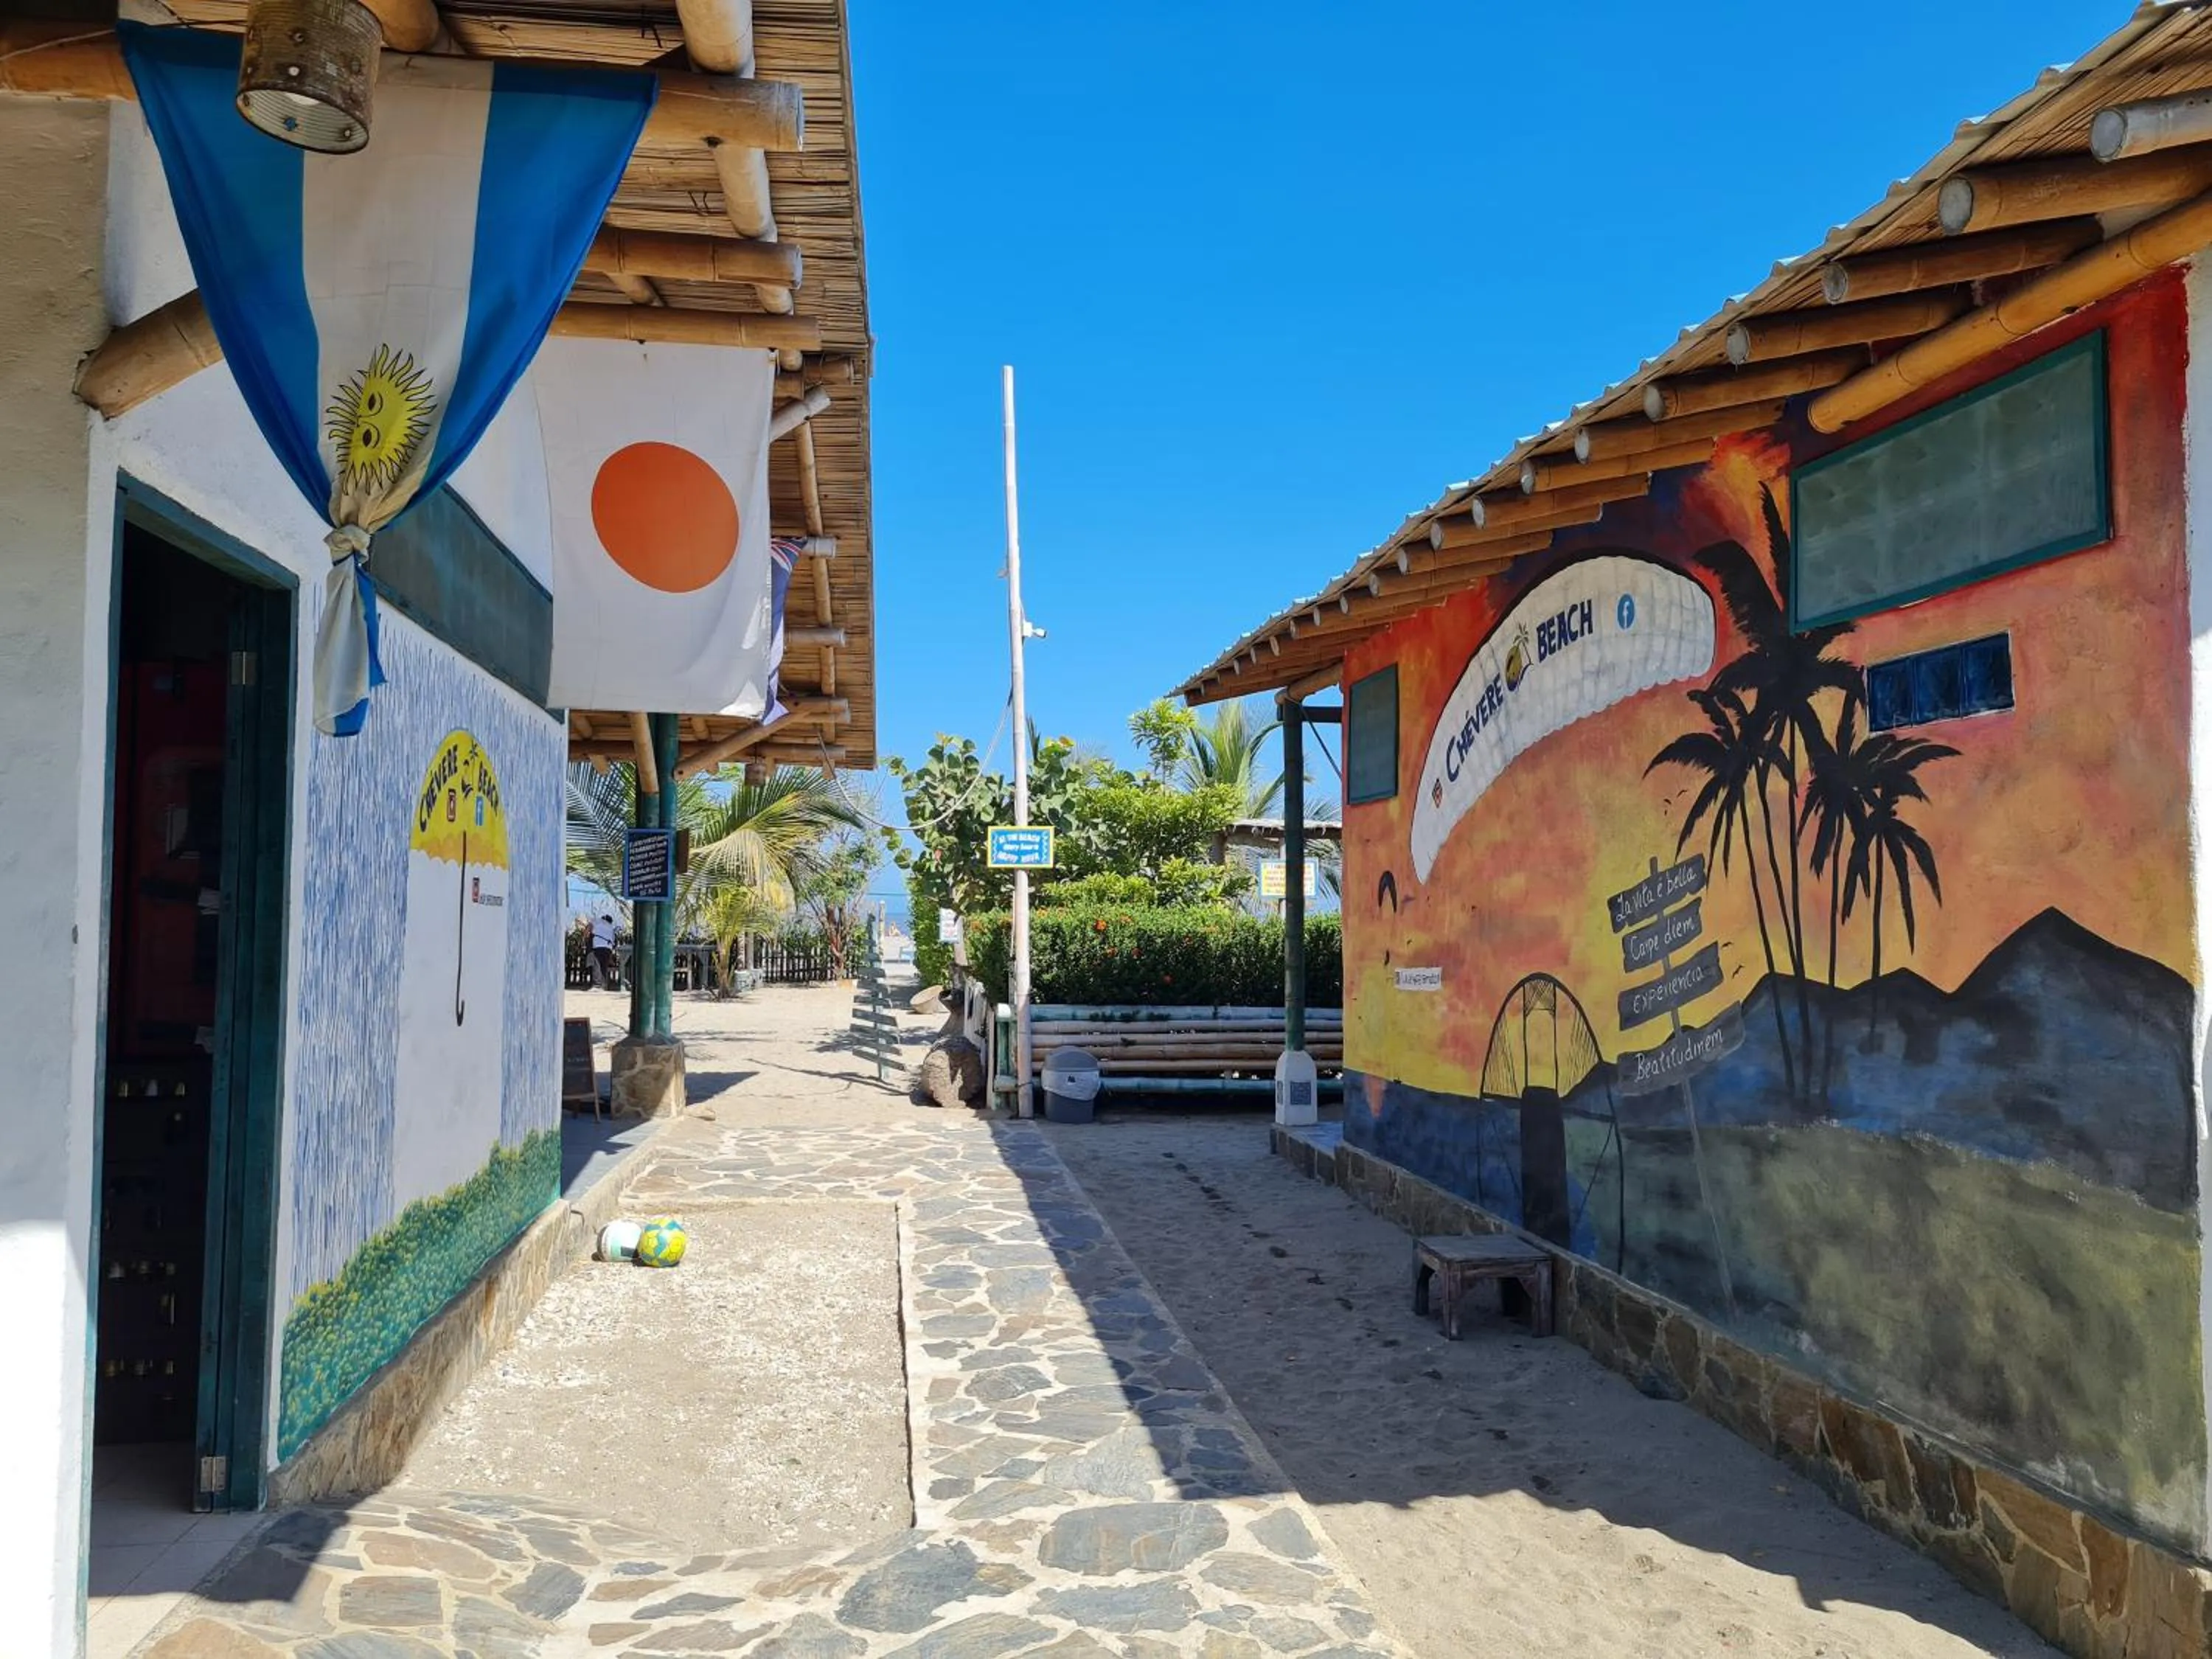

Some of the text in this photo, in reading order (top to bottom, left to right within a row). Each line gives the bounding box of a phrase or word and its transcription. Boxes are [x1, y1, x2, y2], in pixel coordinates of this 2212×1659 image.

[1536, 599, 1593, 664] BEACH
[1632, 883, 1655, 911] vita
[1666, 864, 1697, 895] bella
[1629, 917, 1694, 961] Carpe diem
